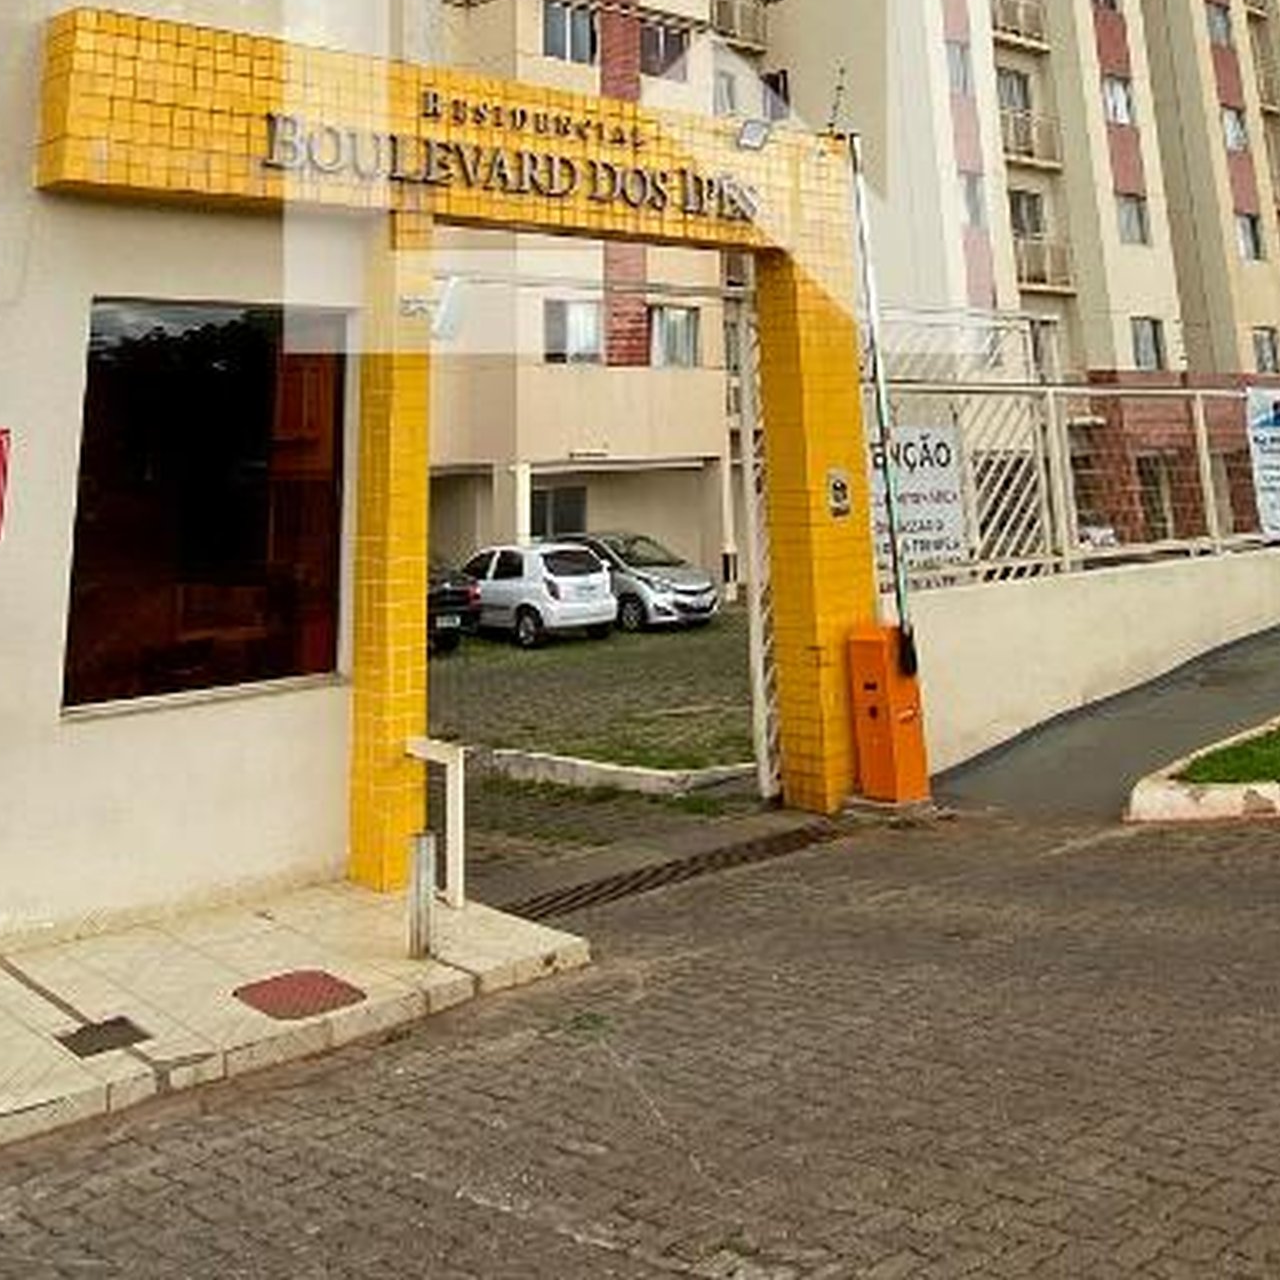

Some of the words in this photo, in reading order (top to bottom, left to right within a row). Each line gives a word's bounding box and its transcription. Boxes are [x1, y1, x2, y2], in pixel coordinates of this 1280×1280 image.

[422, 90, 646, 149] RESIDENCIAL
[262, 112, 577, 199] BOULEVARD
[587, 159, 668, 211] DOS
